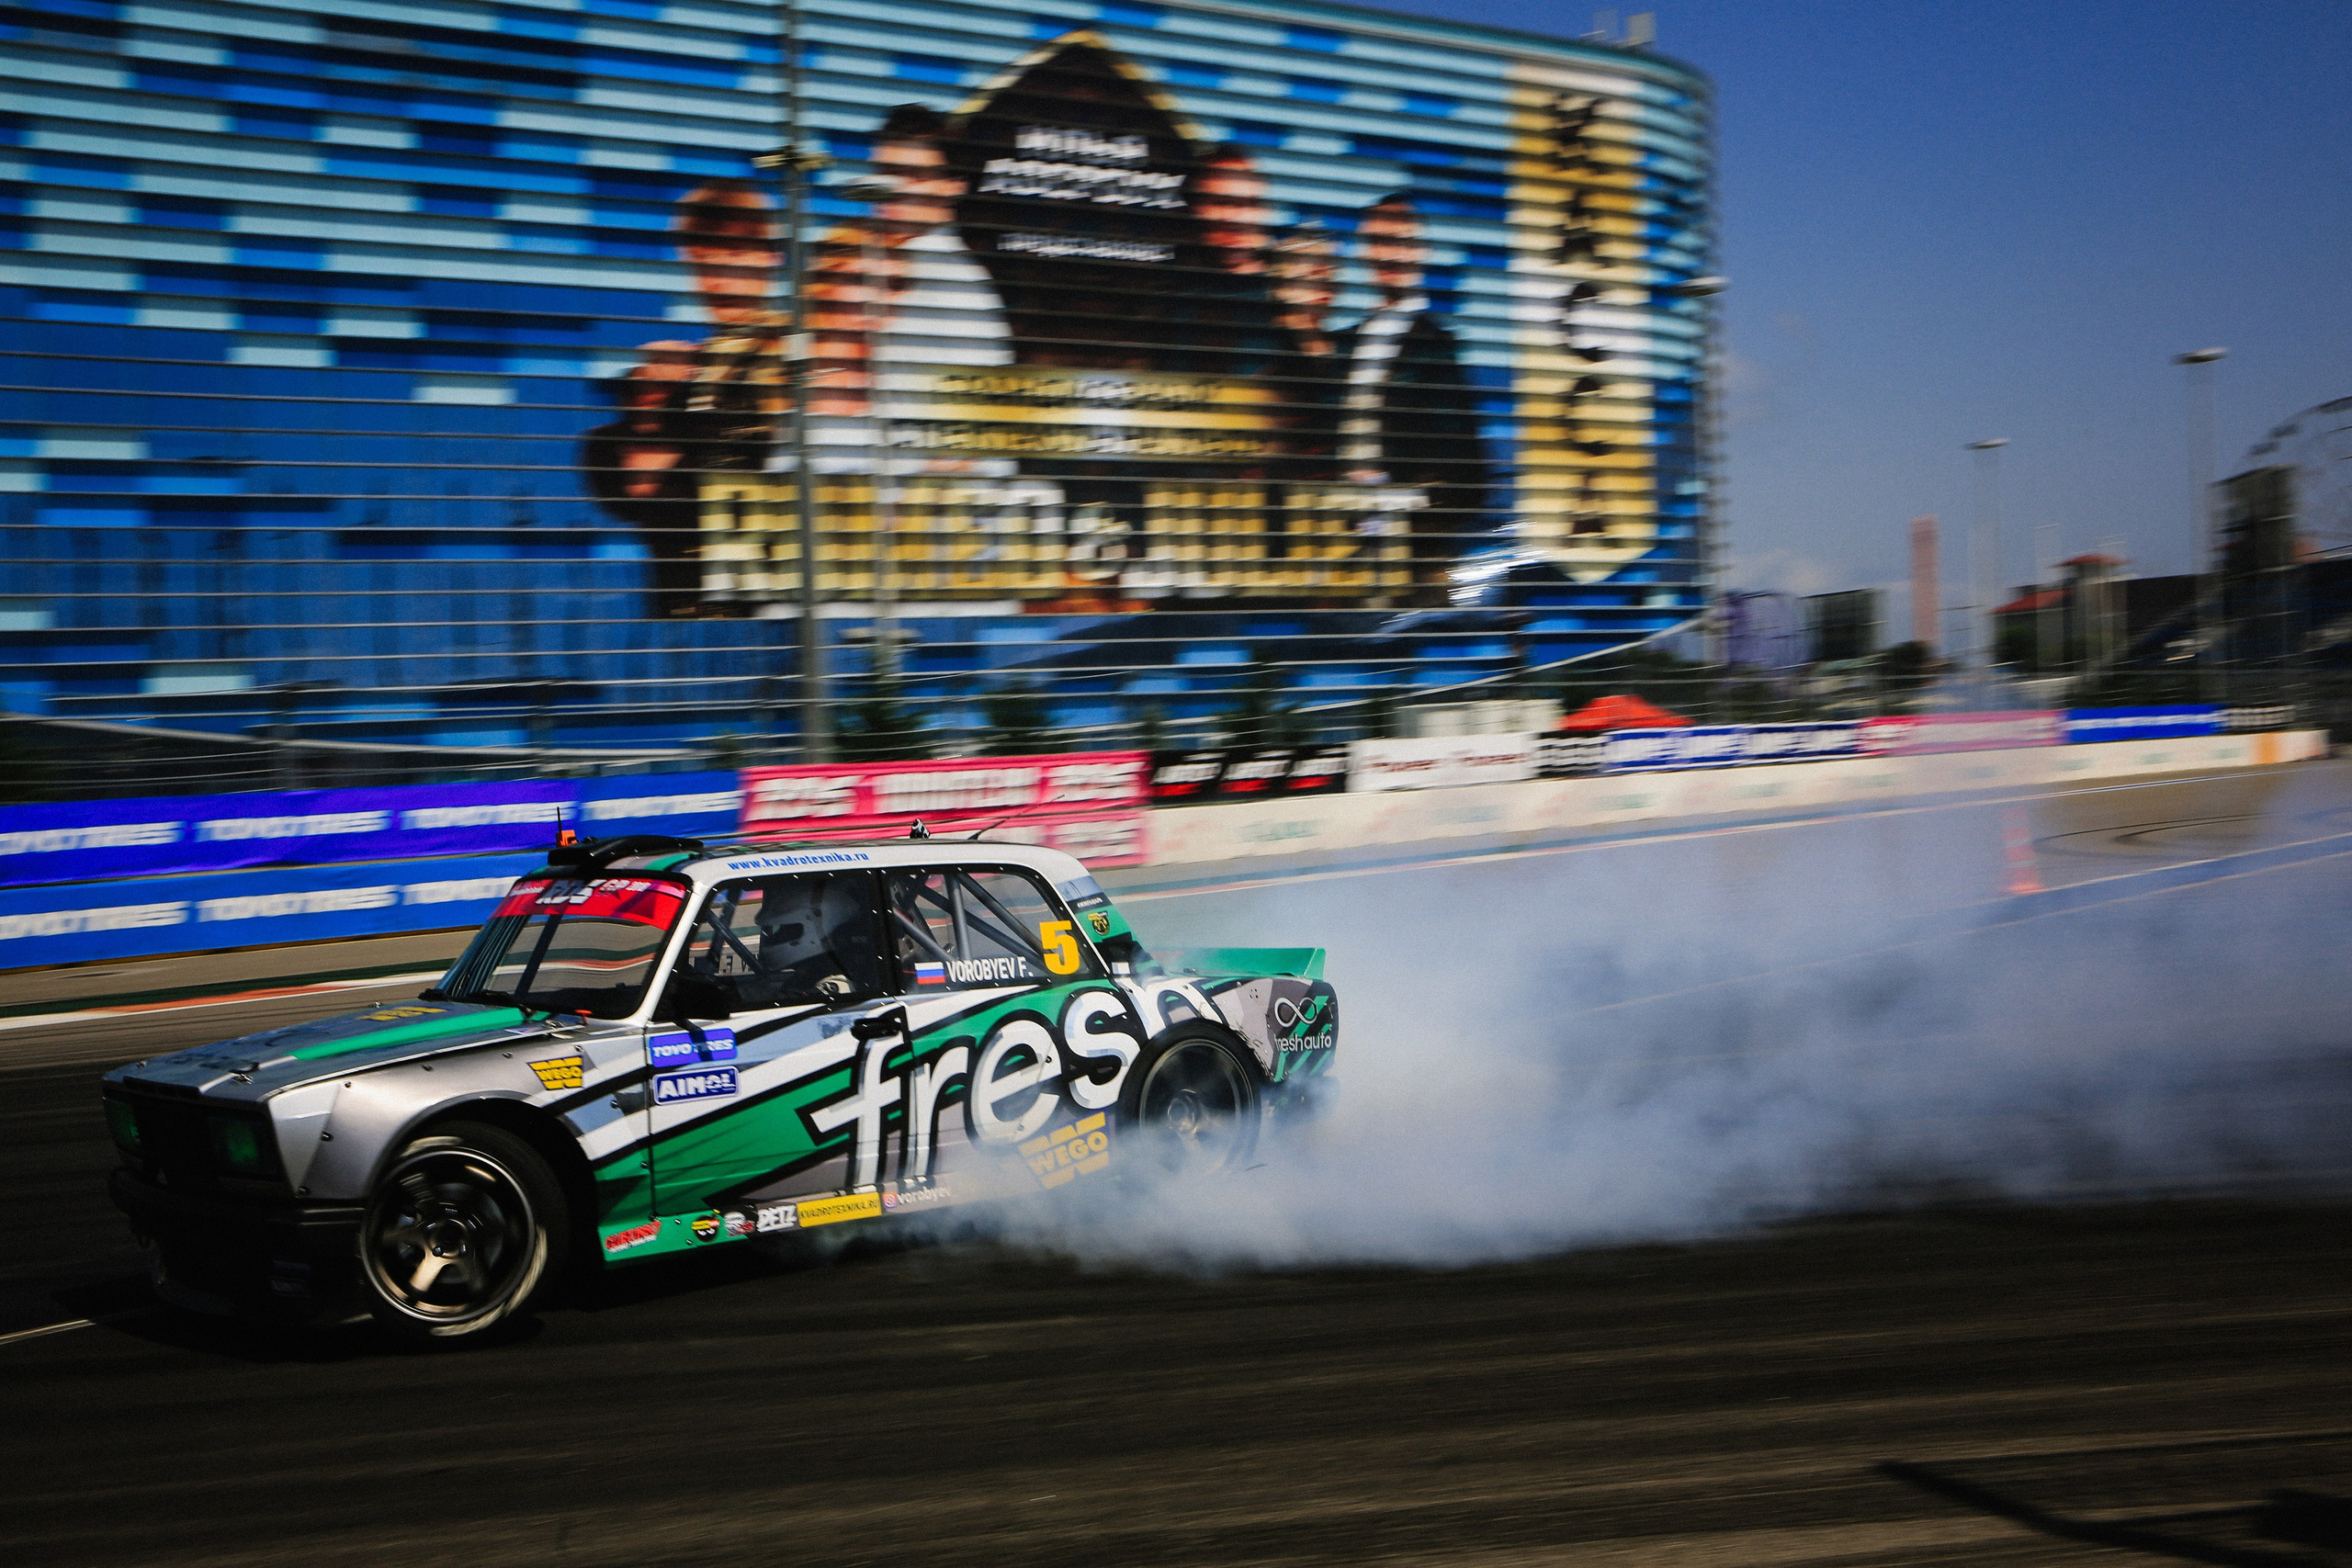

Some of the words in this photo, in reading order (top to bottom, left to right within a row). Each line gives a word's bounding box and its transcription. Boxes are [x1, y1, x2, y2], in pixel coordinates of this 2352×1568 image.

[727, 852, 869, 870] www.kvadrotexnika.ru
[1039, 919, 1080, 976] 5
[945, 958, 1017, 983] VOROBYEV
[1017, 956, 1035, 978] F.
[651, 1043, 693, 1058] TOYO
[535, 1066, 583, 1081] WEGO
[810, 962, 1223, 1193] fresh
[1027, 1132, 1108, 1175] WEGO
